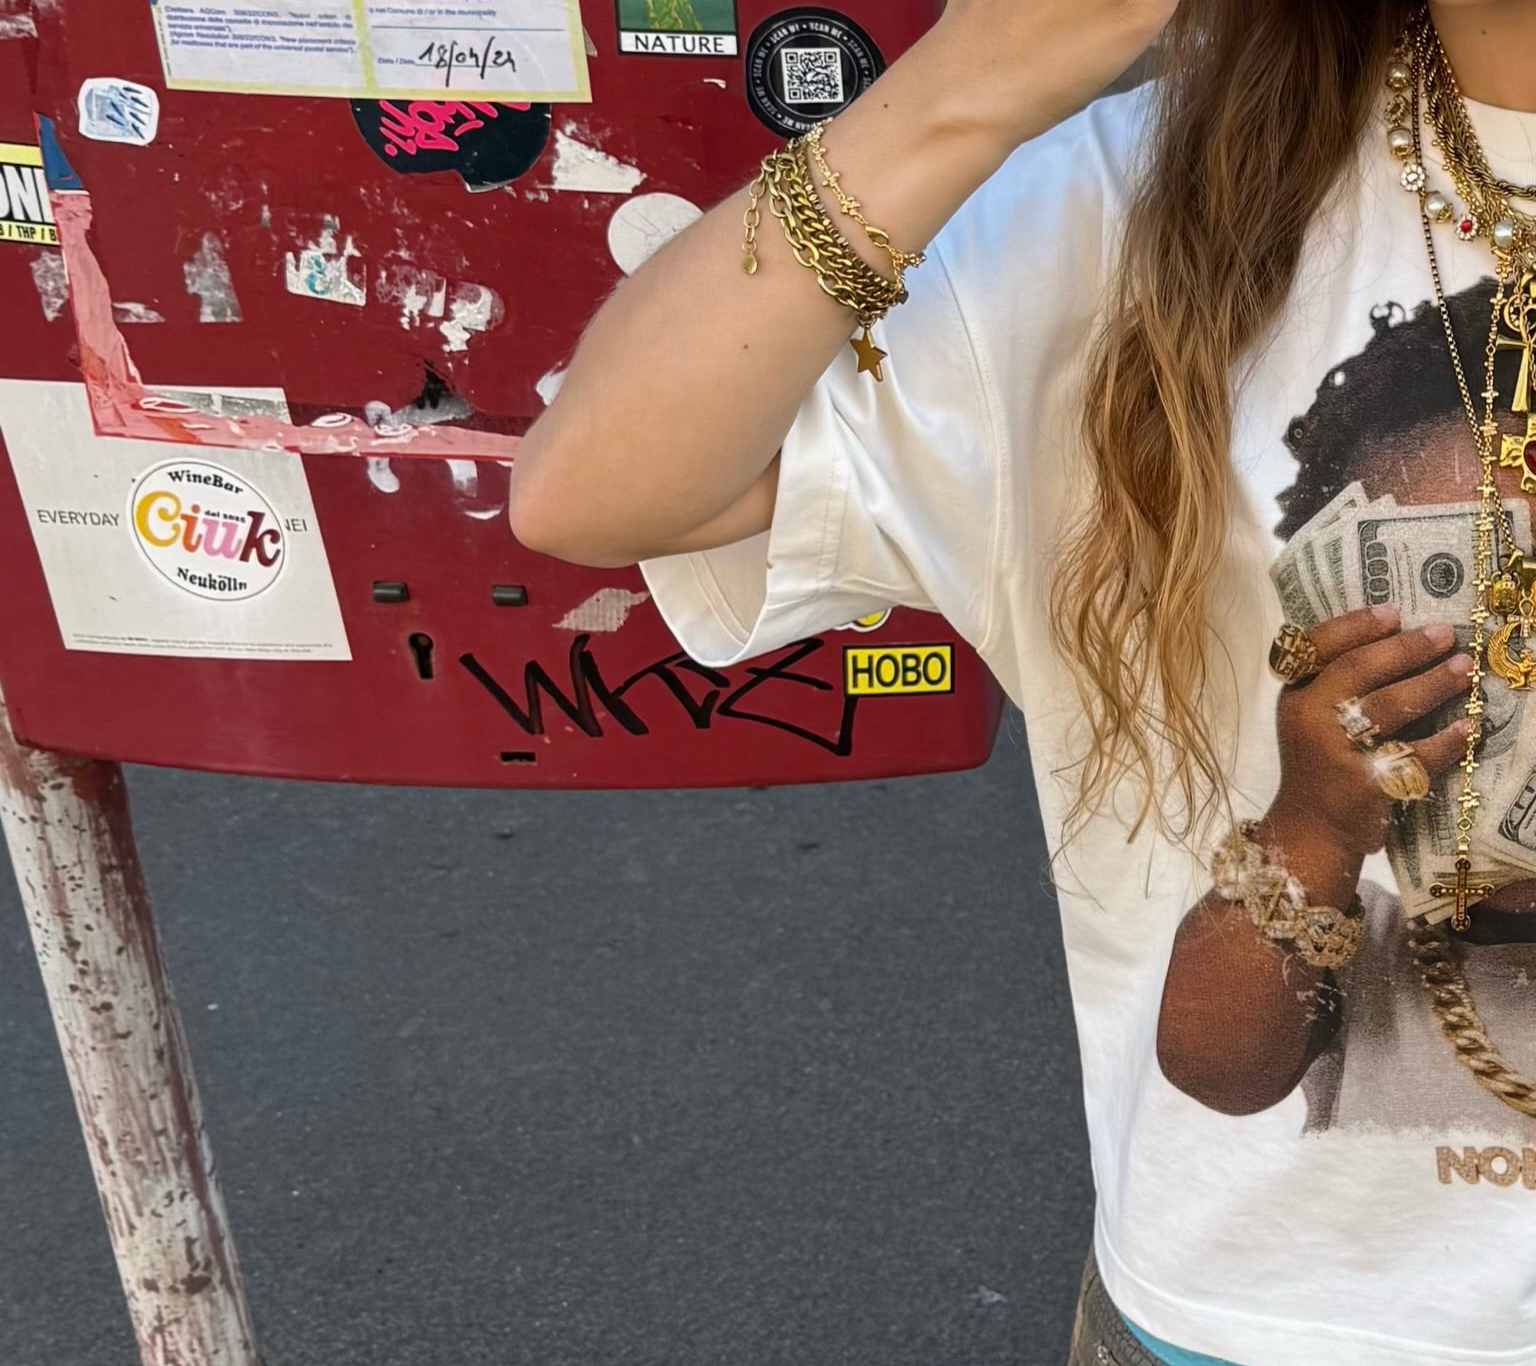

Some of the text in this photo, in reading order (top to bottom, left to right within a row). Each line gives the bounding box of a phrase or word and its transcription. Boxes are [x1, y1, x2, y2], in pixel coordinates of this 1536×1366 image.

[770, 26, 789, 44] SCAN
[809, 22, 843, 39] SCAN ME
[634, 34, 726, 53] NATURE
[16, 225, 37, 240] THP
[167, 469, 244, 495] WineBar
[36, 509, 120, 527] EVERYDAY
[135, 490, 282, 568] Ciuk
[176, 566, 248, 592] Neukölln
[851, 651, 947, 689] HOBO
